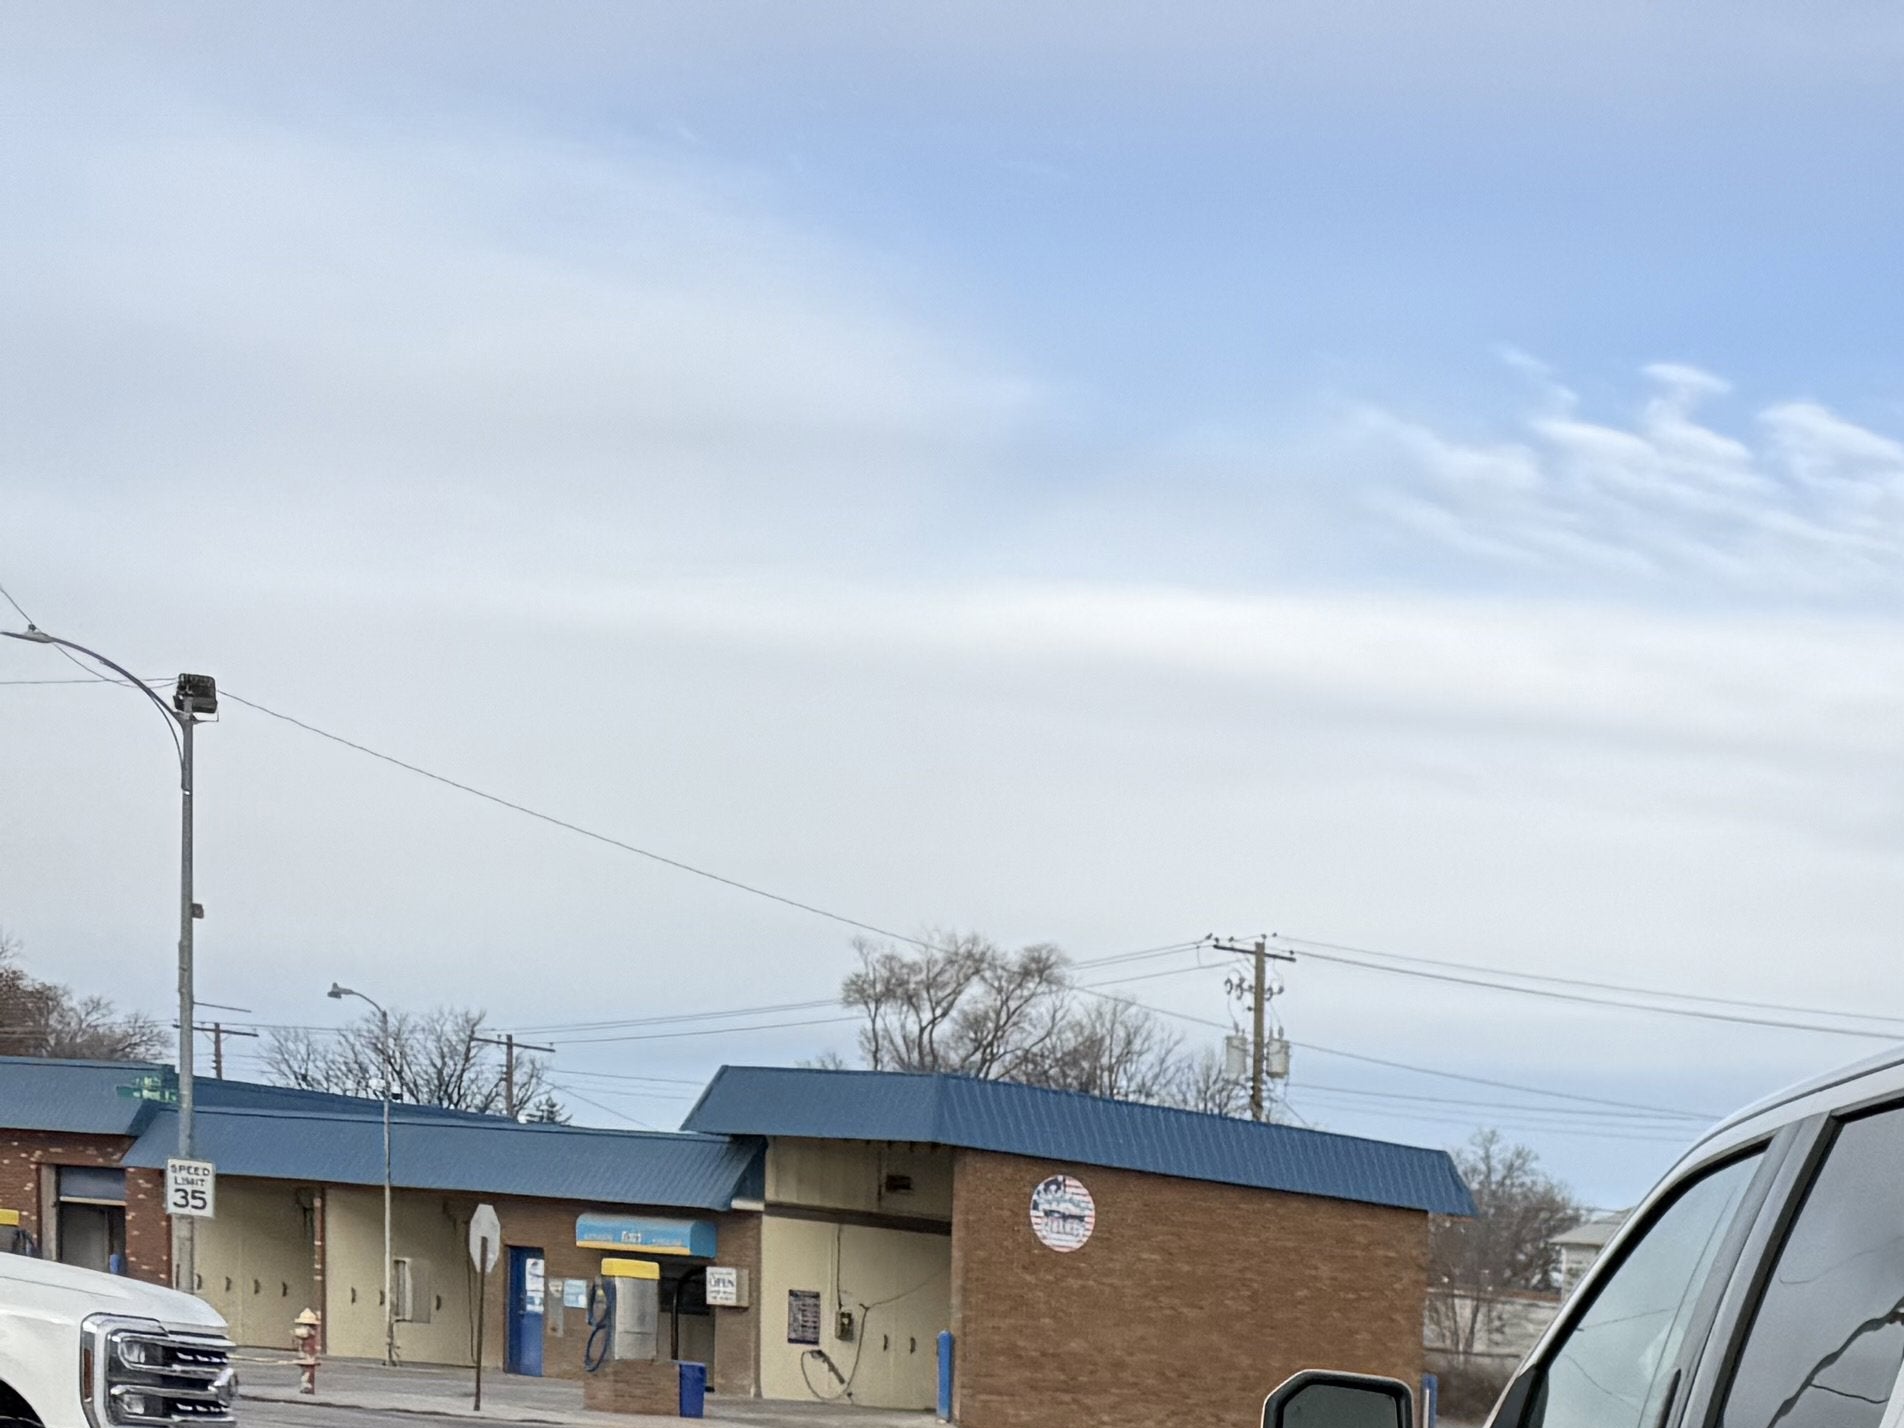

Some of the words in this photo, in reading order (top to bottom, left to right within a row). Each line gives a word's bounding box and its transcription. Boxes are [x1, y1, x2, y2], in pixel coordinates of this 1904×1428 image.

[170, 1164, 210, 1176] SPEED
[174, 1176, 205, 1187] LIMIT
[172, 1188, 207, 1210] 35
